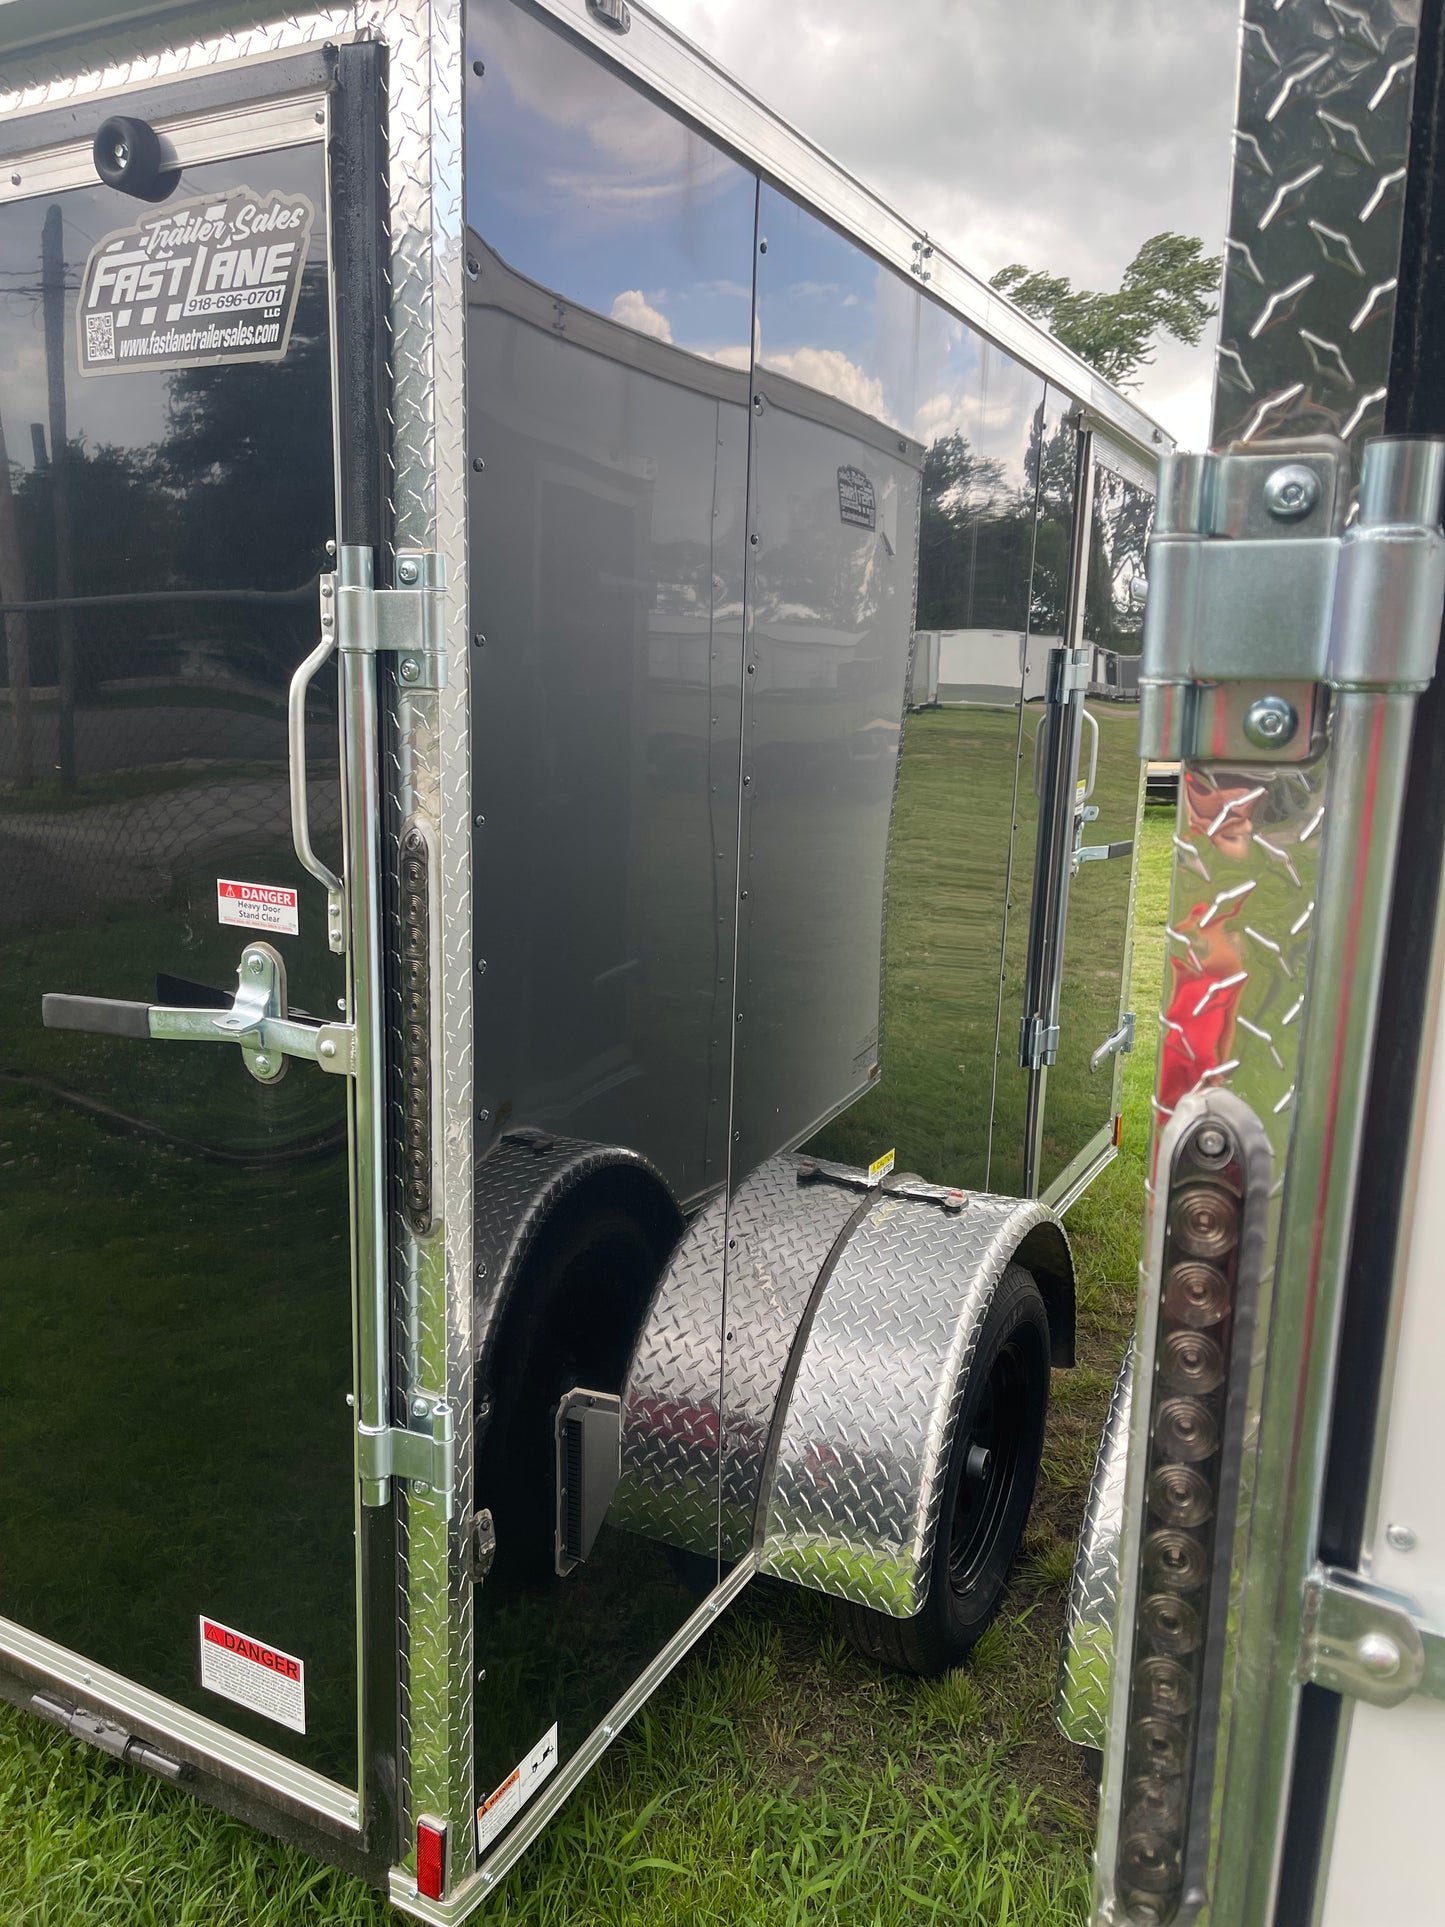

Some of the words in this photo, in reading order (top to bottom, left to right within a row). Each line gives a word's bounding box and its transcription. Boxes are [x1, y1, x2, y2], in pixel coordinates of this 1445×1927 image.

[145, 217, 225, 254] Trailer
[233, 203, 305, 241] Sales
[88, 250, 192, 308] FAST
[187, 242, 296, 301] LANE
[188, 289, 282, 312] 918-696-0701
[263, 308, 281, 318] LLC
[119, 320, 280, 358] www.fastlanetrailersales.com
[237, 901, 260, 911] Heavy
[262, 904, 281, 913] Door
[241, 888, 292, 905] DANGER
[238, 910, 260, 920] Stand
[261, 913, 280, 923] Clear
[224, 1632, 298, 1679] DANGER
